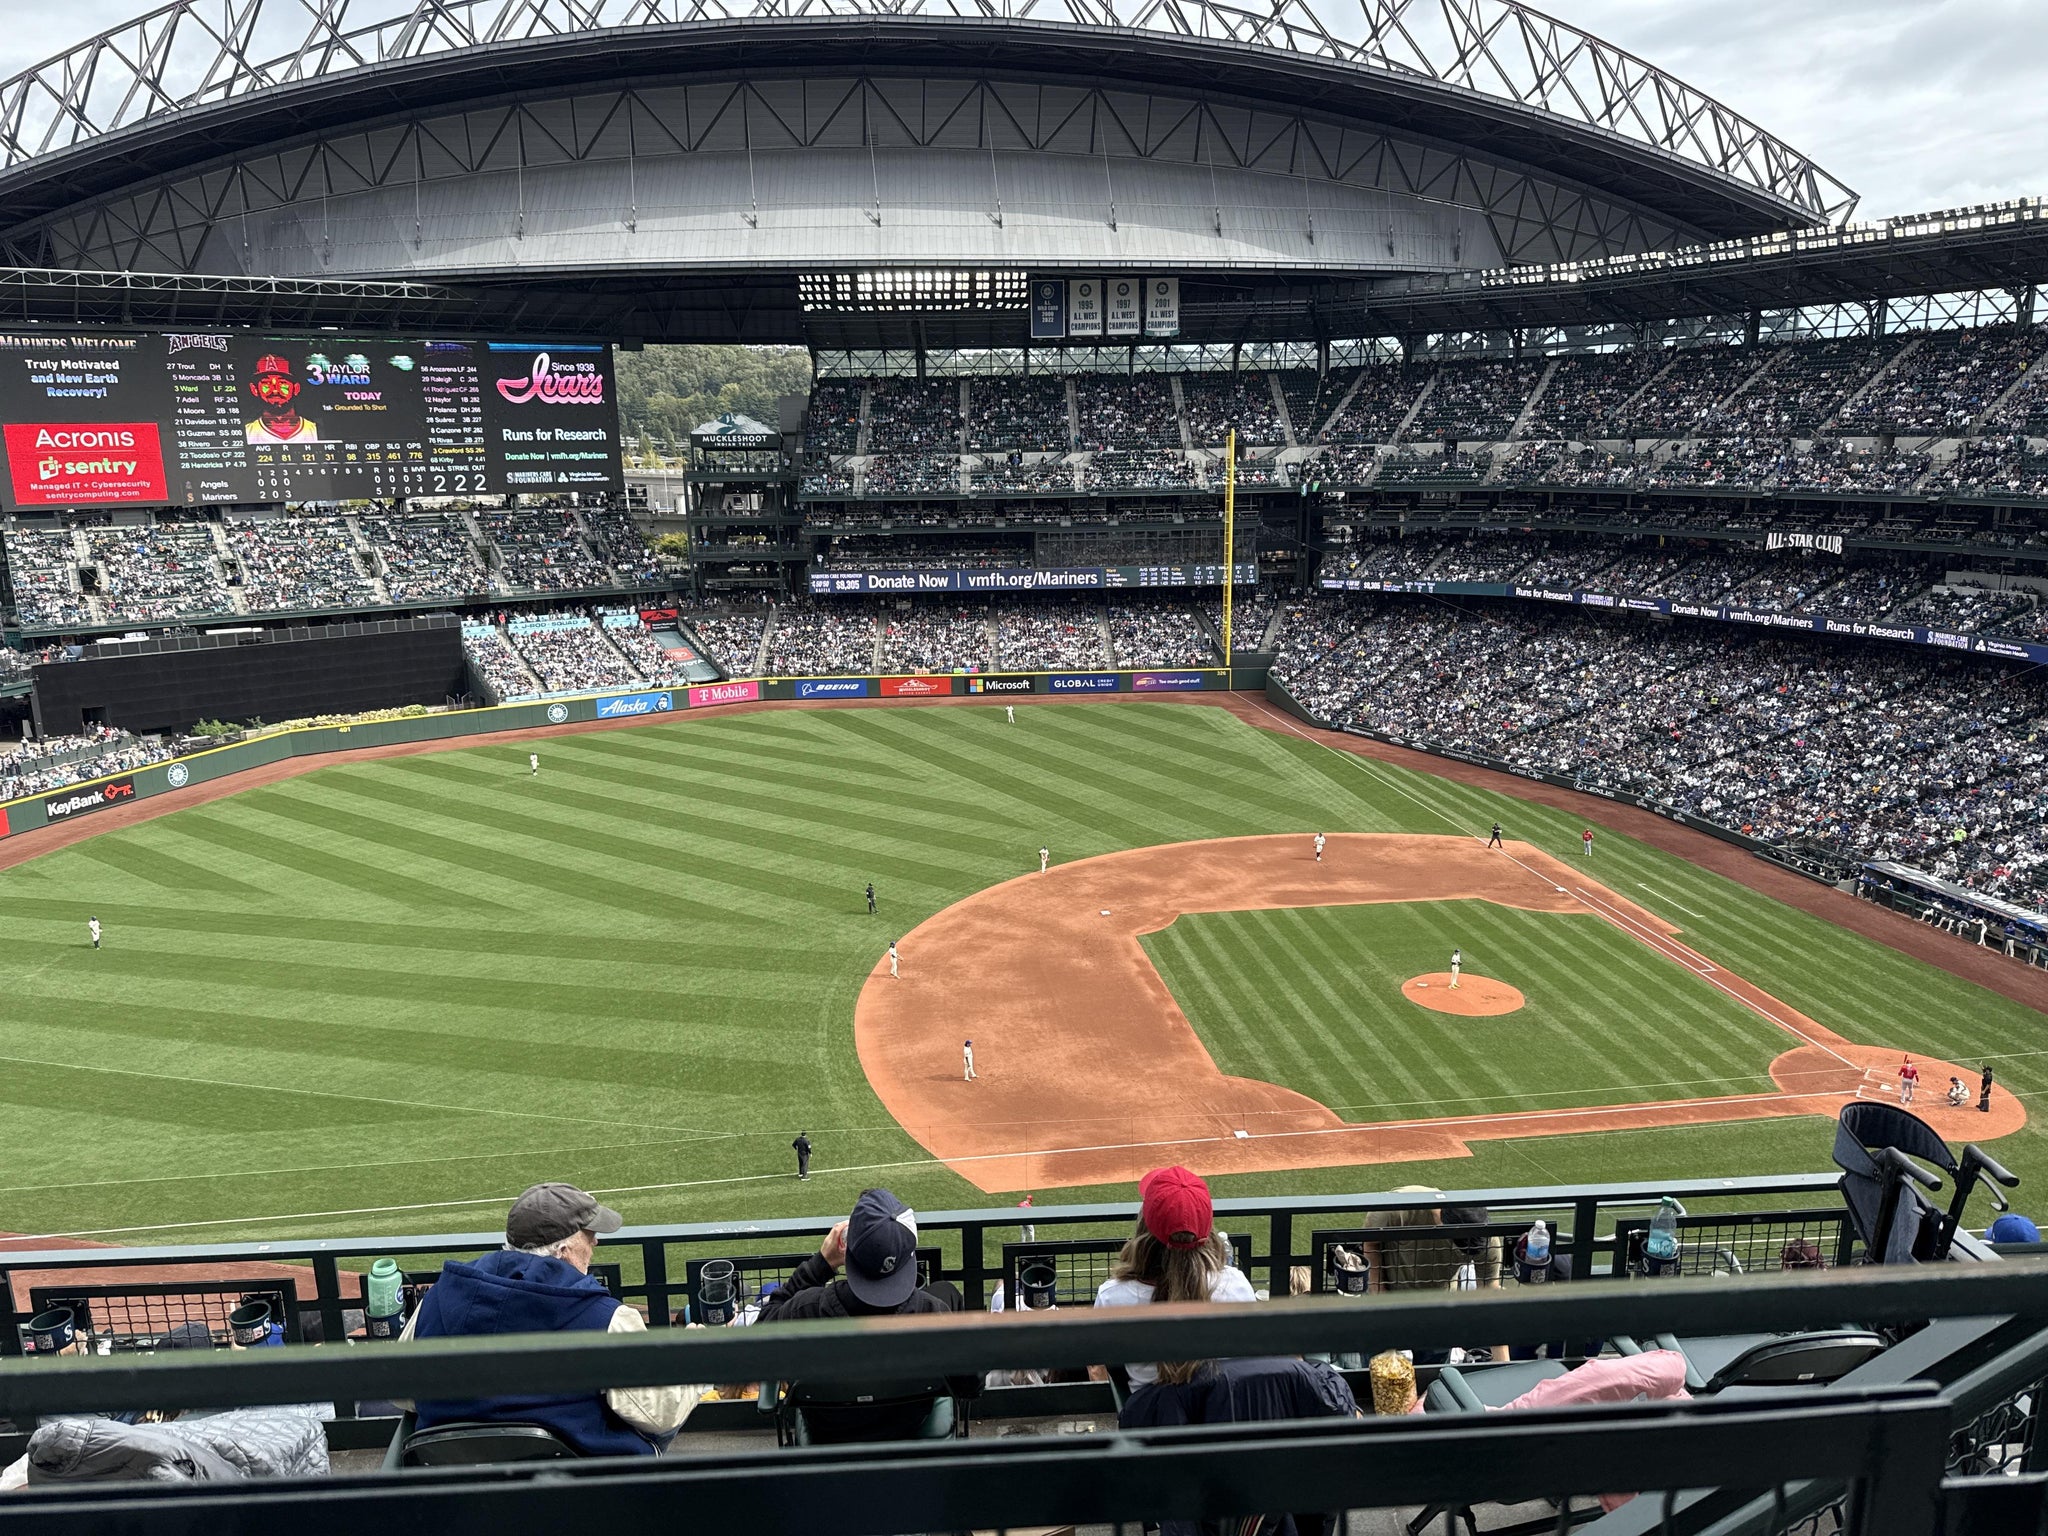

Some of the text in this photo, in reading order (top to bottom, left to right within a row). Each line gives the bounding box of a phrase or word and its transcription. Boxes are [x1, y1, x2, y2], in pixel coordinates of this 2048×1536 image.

[1078, 300, 1093, 310] 1995
[1116, 300, 1130, 308] 1997
[1155, 299, 1170, 308] 2001
[1084, 312, 1097, 320] WEST
[1160, 310, 1174, 318] WEST
[1071, 322, 1101, 330] CHAMPIONS
[1109, 322, 1138, 330] CHAMPIONS
[168, 334, 228, 354] ANGELS
[25, 360, 120, 371] Truly Motivated
[326, 364, 370, 374] TAYLOR
[551, 362, 595, 372] Since 1938
[31, 373, 118, 383] and New Earth
[306, 364, 325, 386] 3
[325, 373, 370, 385] WARD
[496, 352, 603, 404] Ivar's
[46, 387, 107, 398] Recovery!
[344, 392, 382, 400] TODAY
[35, 428, 135, 448] Acronis
[502, 428, 607, 441] Runs for Research
[282, 454, 292, 462] 81
[505, 452, 529, 460] Donate
[65, 458, 137, 475] sentry
[30, 482, 70, 491] Managed
[91, 480, 151, 489] Cybersecurity
[200, 481, 229, 489] Angels
[258, 474, 423, 487] 0 0 0 0 0 0 3
[434, 474, 487, 492] 2 2 2
[45, 490, 140, 500] sentrycomputing.com
[260, 491, 266, 499] 2
[272, 490, 279, 498] 0
[285, 490, 292, 498] 3
[376, 487, 382, 495] 5
[404, 486, 411, 494] 0
[418, 486, 424, 494] 4
[1816, 534, 1843, 555] CLUB
[836, 580, 860, 590] $9,305
[868, 574, 949, 589] Donate Now
[968, 571, 1098, 588] vmfh.org/Mariners
[1515, 587, 1573, 602] Runs for Research
[1671, 603, 1813, 628] Donate Now vmfh.org/Mariners
[1826, 620, 1914, 640] Runs for Research
[1934, 638, 1968, 650] FOUNDATION
[816, 683, 859, 691] BOEING
[985, 680, 1030, 690] Microsoft
[1054, 679, 1096, 688] GLOBAL
[711, 686, 748, 700] Mobile
[601, 699, 648, 716] Alaska
[46, 791, 105, 816] KeyBank
